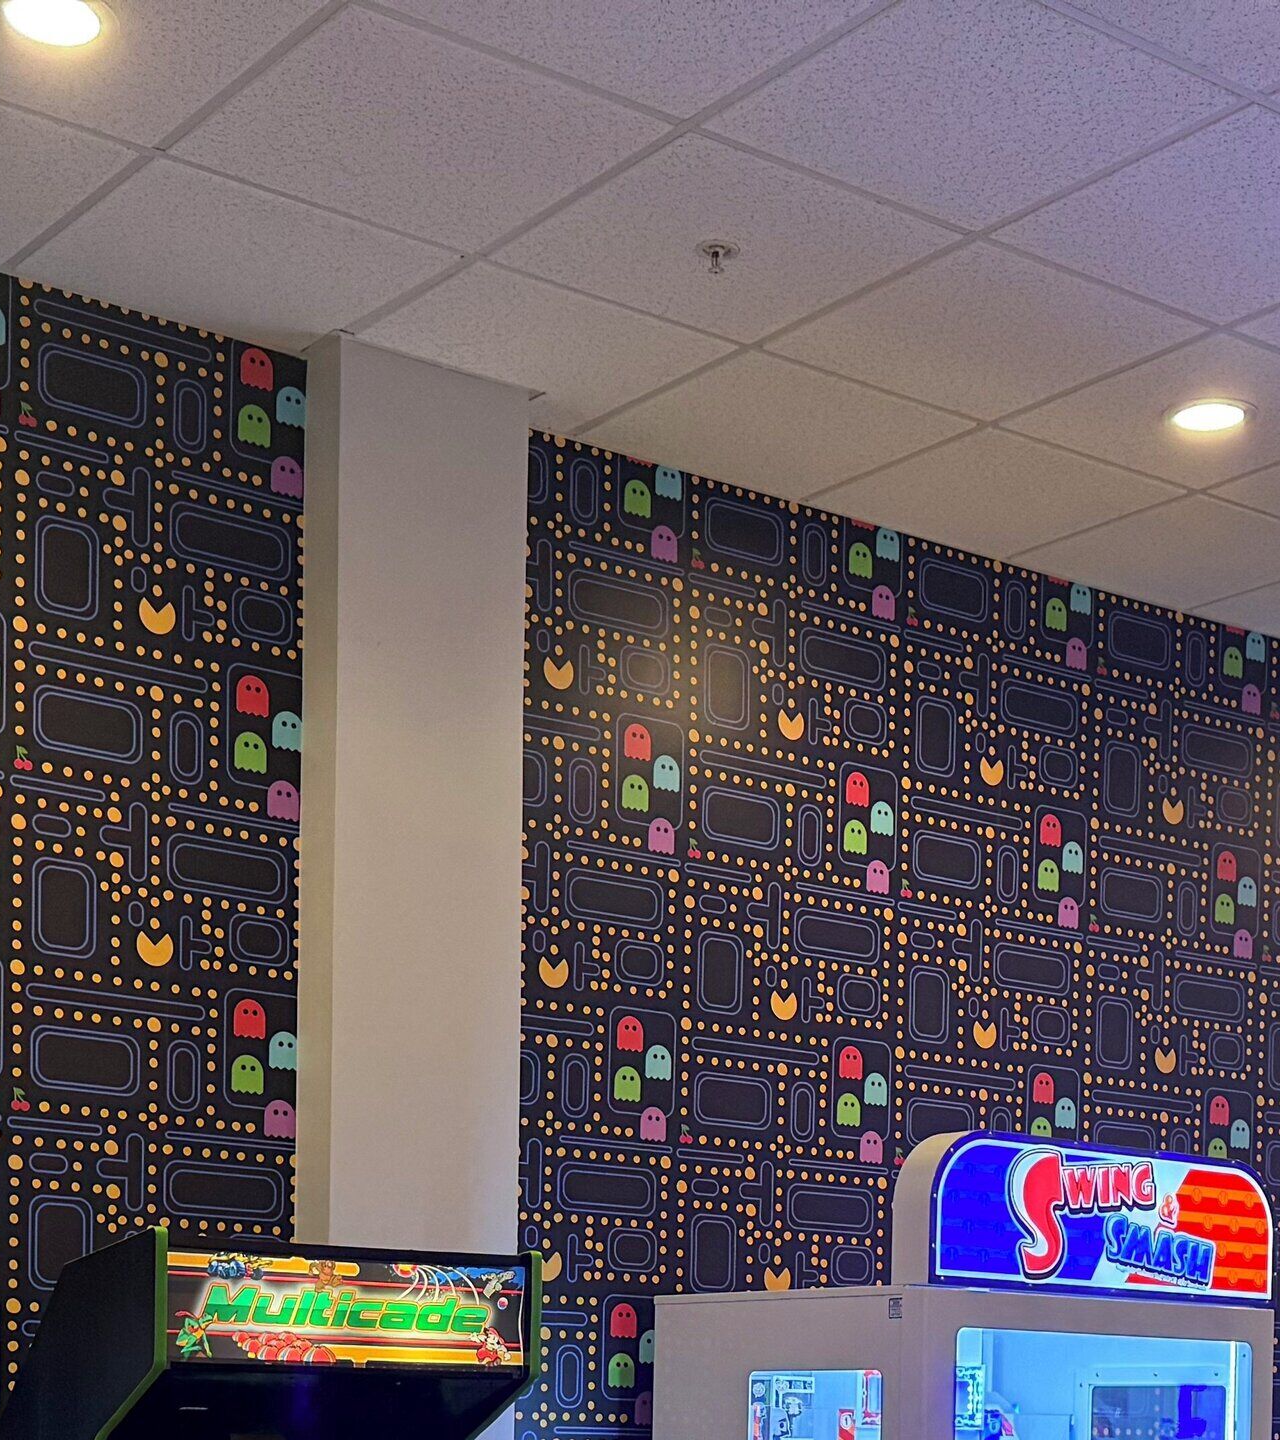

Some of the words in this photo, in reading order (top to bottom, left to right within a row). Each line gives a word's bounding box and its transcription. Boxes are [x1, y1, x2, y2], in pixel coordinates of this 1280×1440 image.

[1010, 1149, 1156, 1280] SWING
[1160, 1194, 1179, 1226] &
[1106, 1214, 1215, 1284] SMASH
[203, 1282, 492, 1333] Multicade
